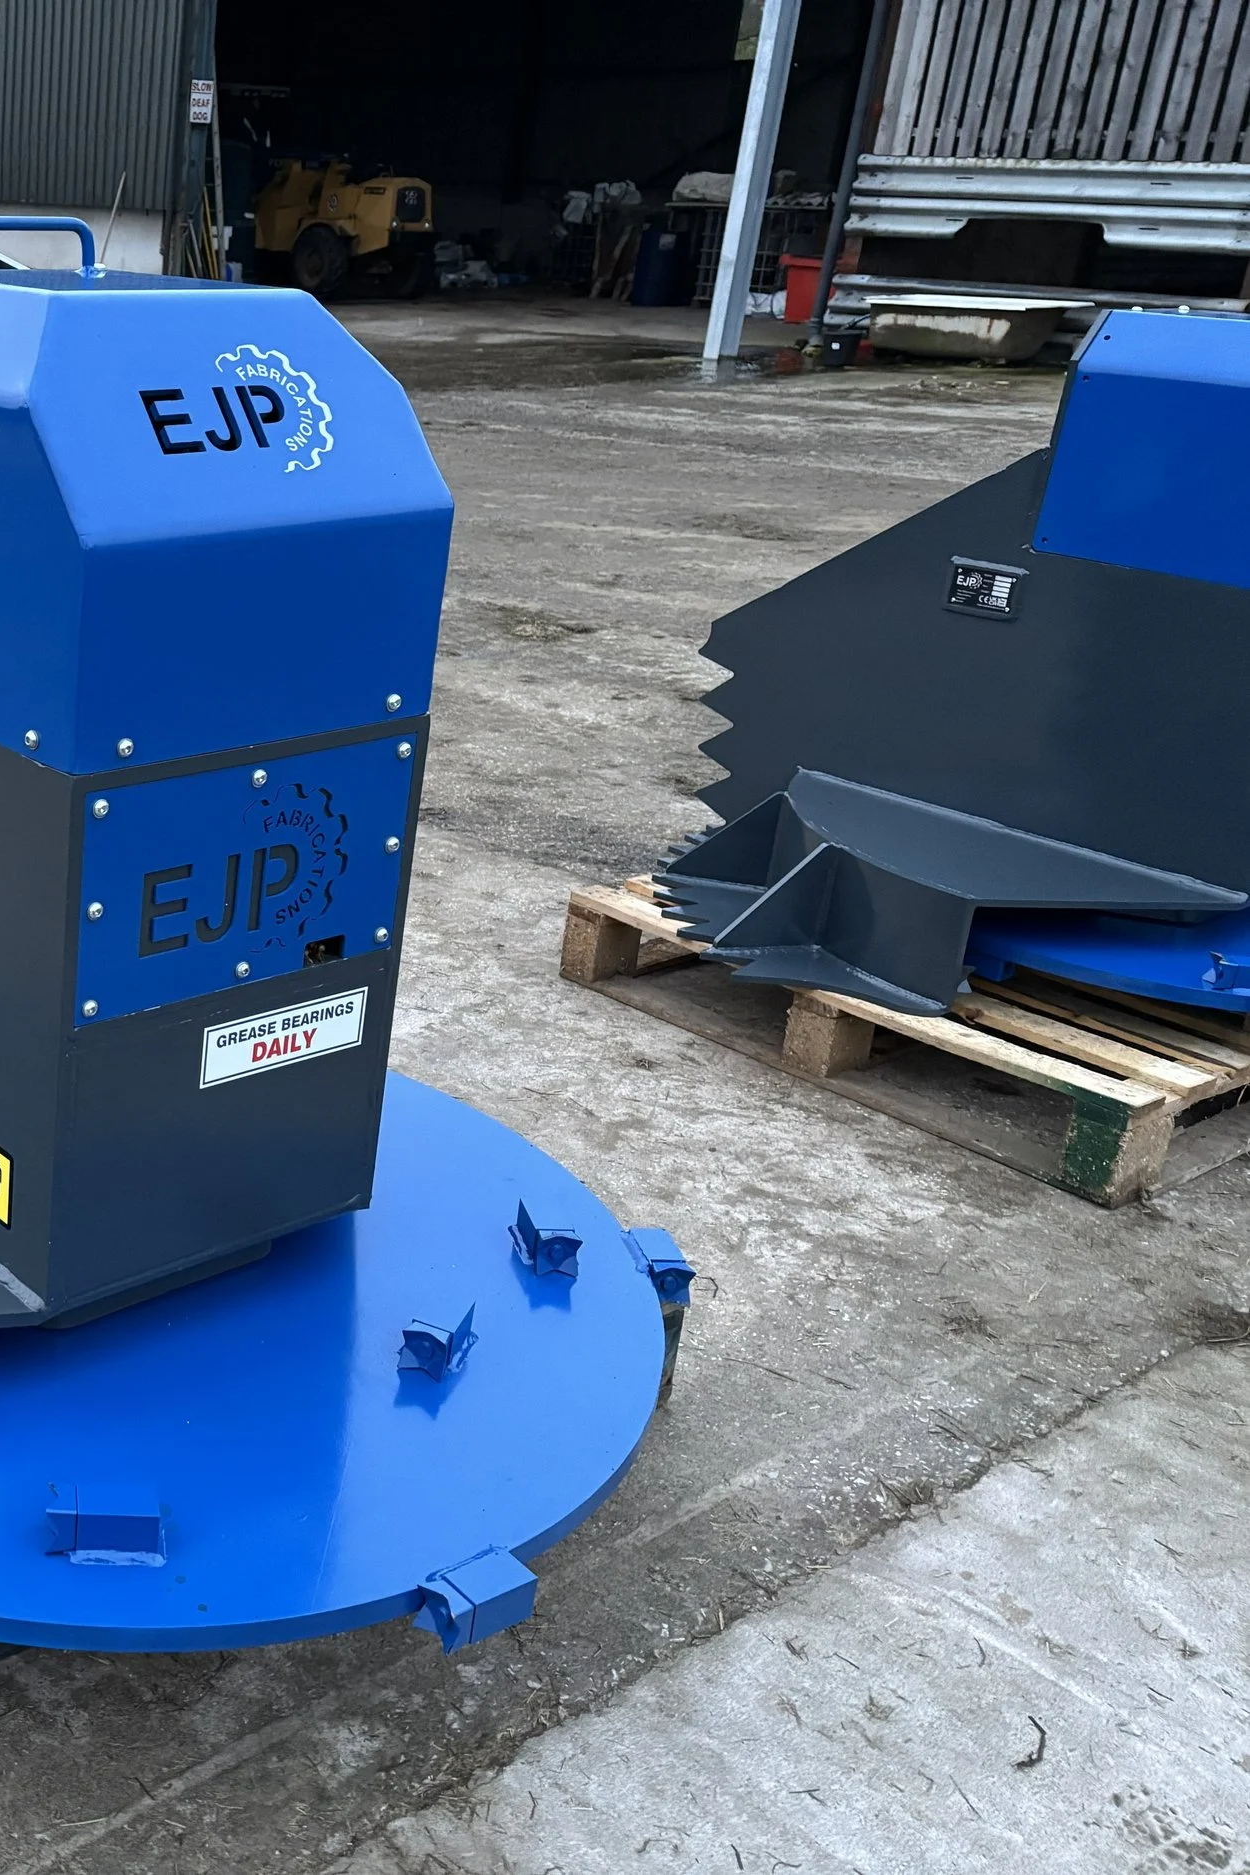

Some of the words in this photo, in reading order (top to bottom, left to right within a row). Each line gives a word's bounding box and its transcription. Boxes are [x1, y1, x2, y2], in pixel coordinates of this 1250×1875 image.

[192, 83, 212, 92] SLOW
[192, 98, 210, 107] DEAF
[192, 111, 208, 121] DOG
[138, 385, 285, 455] EJP
[235, 364, 313, 451] FABRICATIONS
[957, 575, 977, 587] EJP
[263, 808, 326, 925] FABRICATIONS
[138, 843, 299, 958] EJP
[216, 1021, 277, 1048] GREASE
[281, 1001, 354, 1032] BEARINGS
[251, 1028, 318, 1063] DAILY
